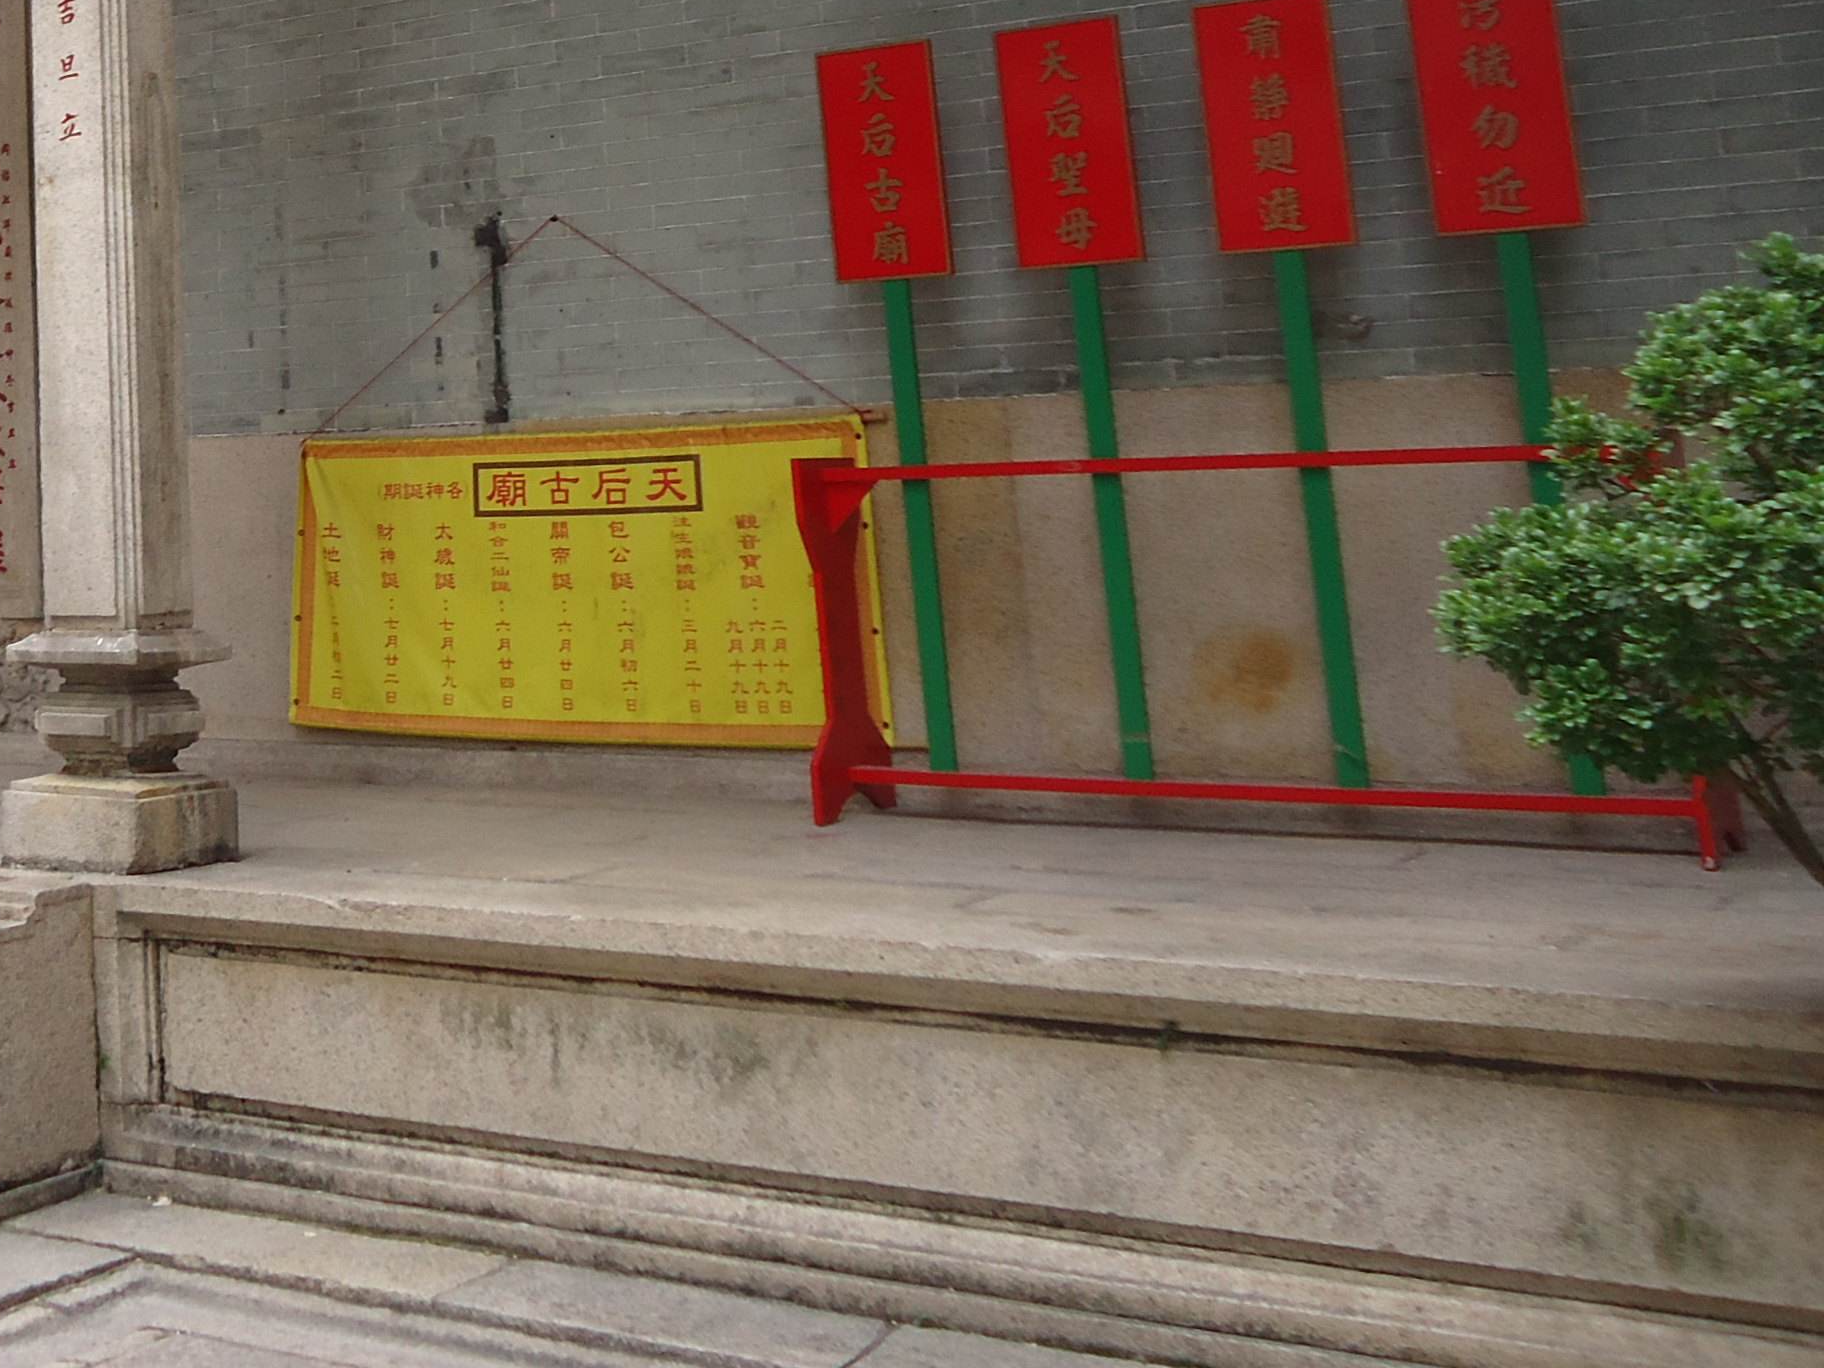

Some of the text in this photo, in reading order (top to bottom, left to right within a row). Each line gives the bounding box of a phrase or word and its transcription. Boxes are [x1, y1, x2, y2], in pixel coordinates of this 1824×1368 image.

[858, 61, 910, 265] 天后古廟
[1039, 40, 1098, 250] 天后聖母
[486, 467, 689, 507] 天后古廟
